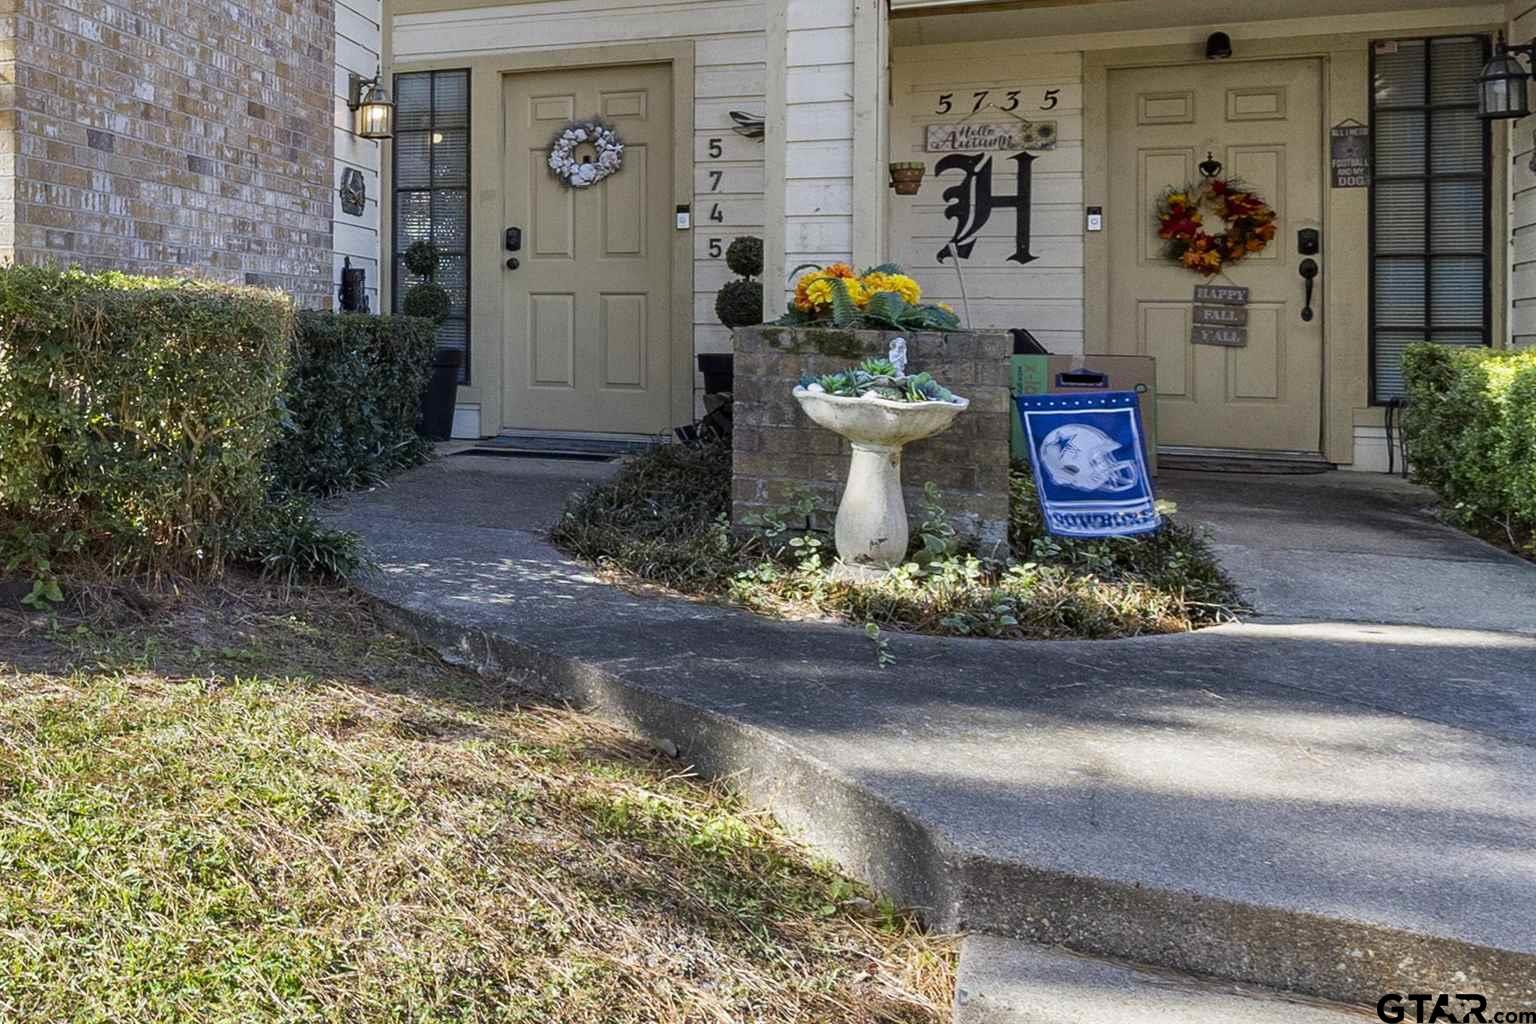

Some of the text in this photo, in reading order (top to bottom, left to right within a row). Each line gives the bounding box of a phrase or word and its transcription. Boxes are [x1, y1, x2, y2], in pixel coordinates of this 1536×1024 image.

[935, 88, 1061, 115] 5735
[934, 151, 1041, 265] H
[1197, 287, 1246, 301] HAPPY
[1203, 309, 1238, 321] FALL
